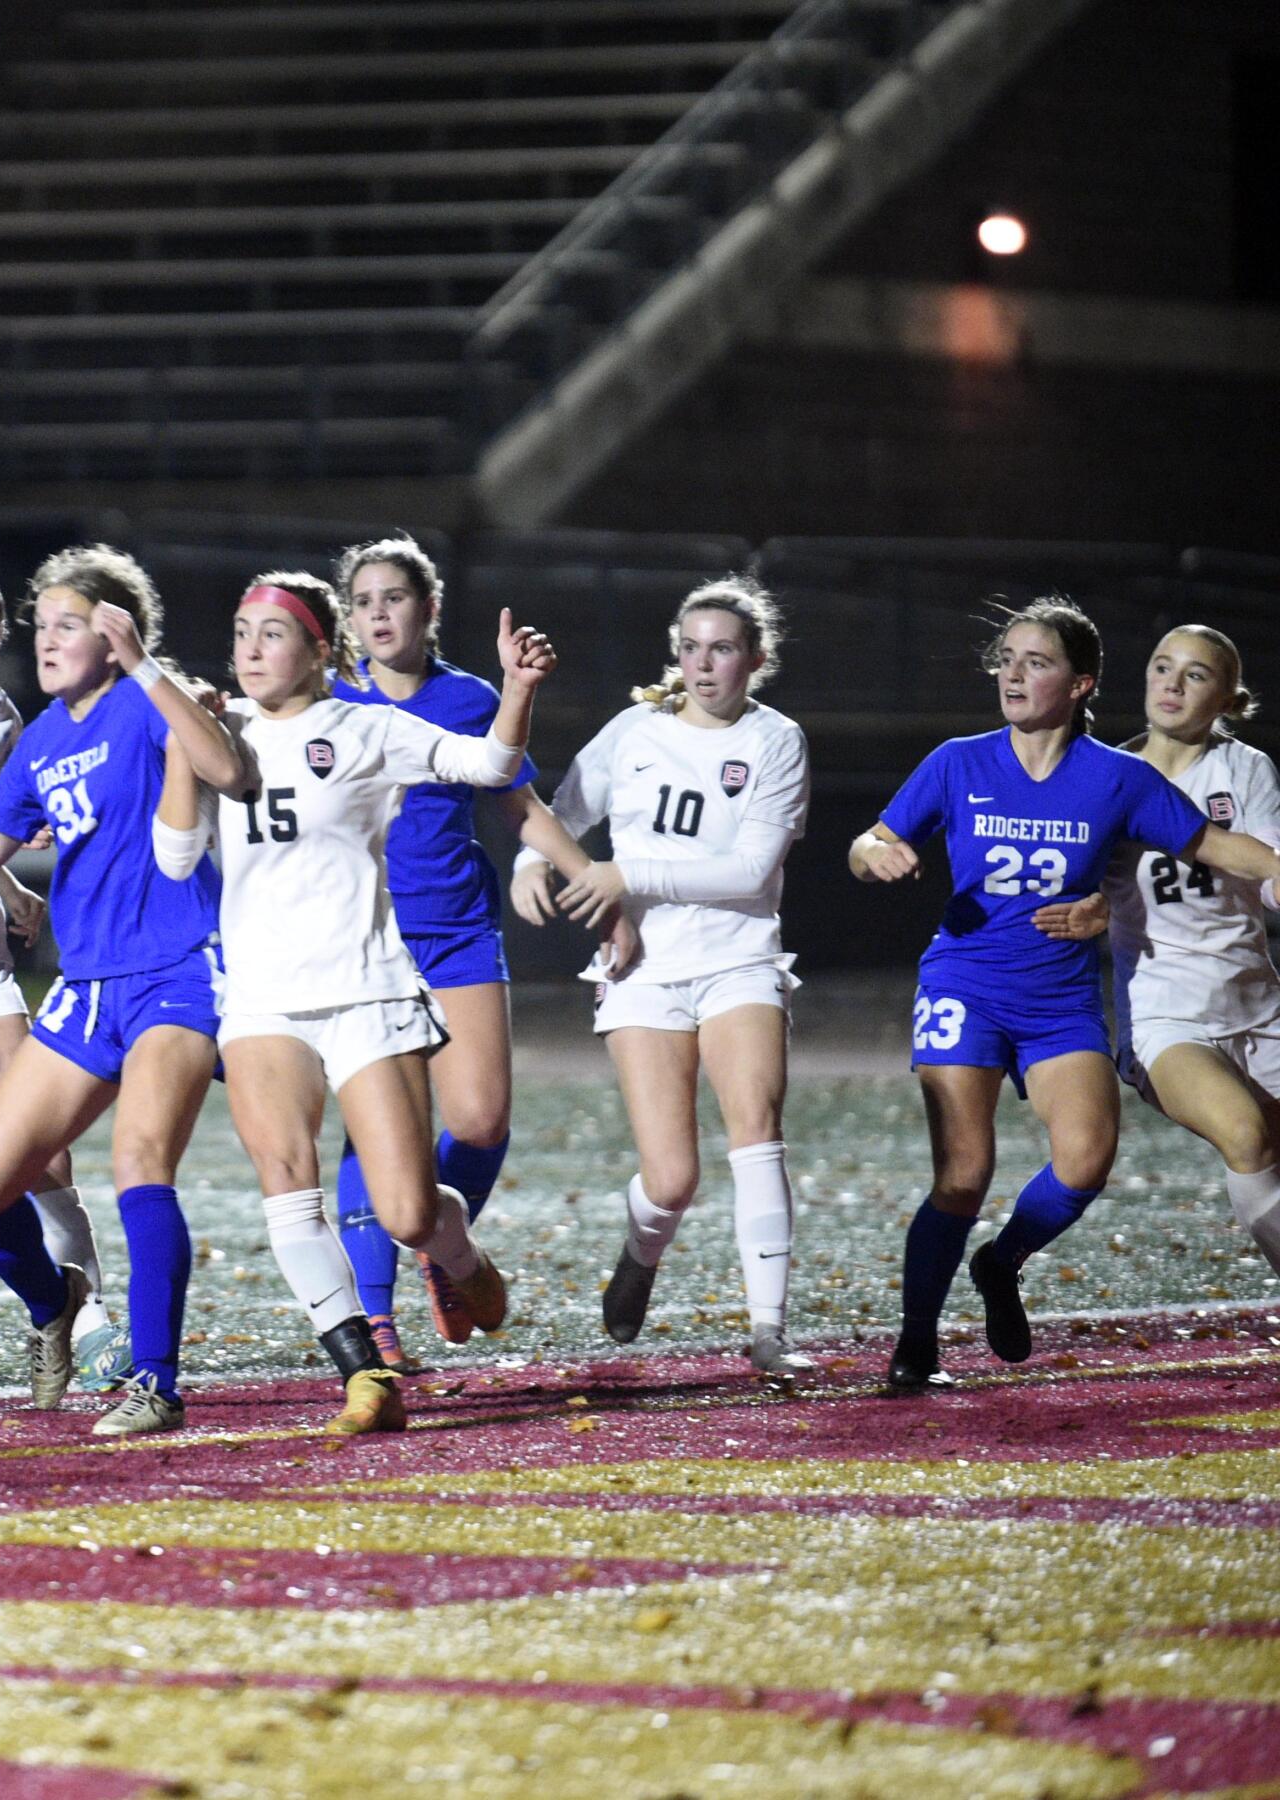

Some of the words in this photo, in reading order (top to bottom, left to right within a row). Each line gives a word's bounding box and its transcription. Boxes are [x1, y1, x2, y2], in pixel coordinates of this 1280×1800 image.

[308, 744, 335, 767] B
[723, 764, 746, 785] B
[47, 778, 98, 844] 31
[244, 788, 298, 844] 15
[653, 783, 705, 837] 10
[974, 814, 1089, 843] RIDGEFIELD
[1209, 797, 1232, 820] B
[984, 844, 1067, 897] 23
[1151, 856, 1214, 905] 24
[914, 997, 966, 1049] 23
